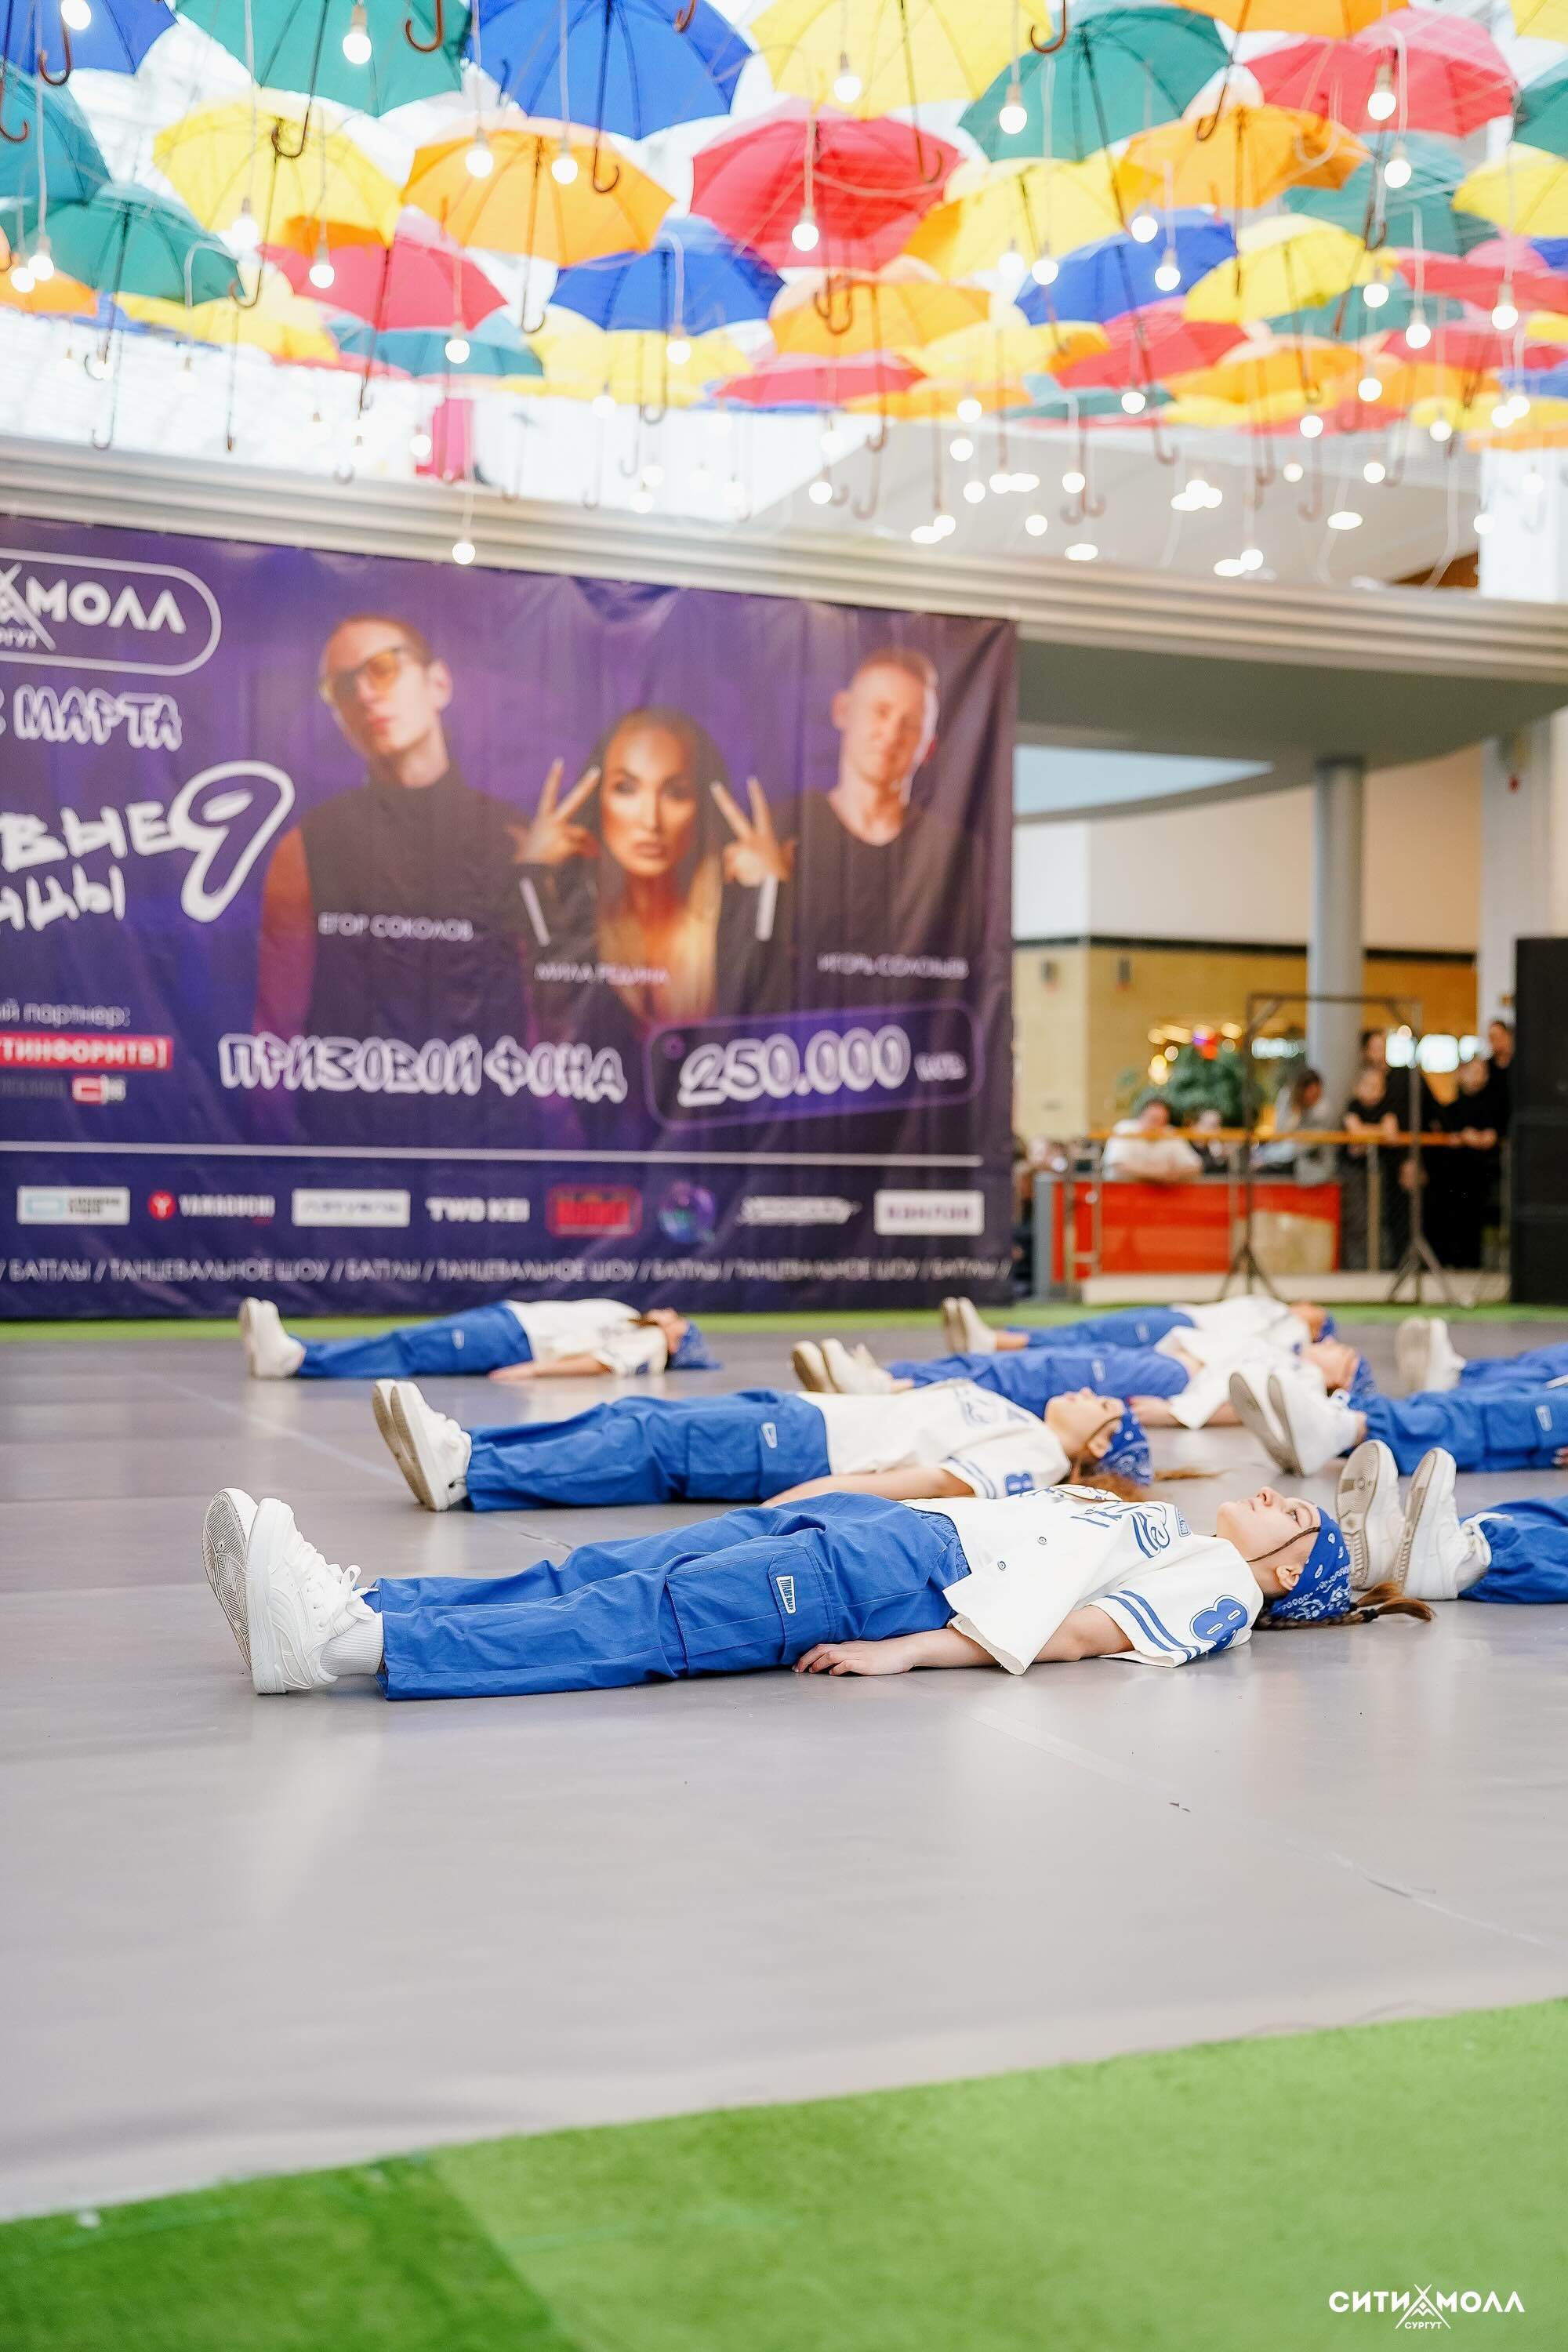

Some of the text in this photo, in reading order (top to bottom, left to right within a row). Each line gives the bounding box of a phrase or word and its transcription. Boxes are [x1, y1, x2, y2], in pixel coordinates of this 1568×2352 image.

[26, 575, 187, 634] МОЛЛ
[13, 684, 183, 752] МАРТА
[318, 912, 474, 942] ЕГОР СОКОЛОВ
[677, 1024, 911, 1108] 250.000
